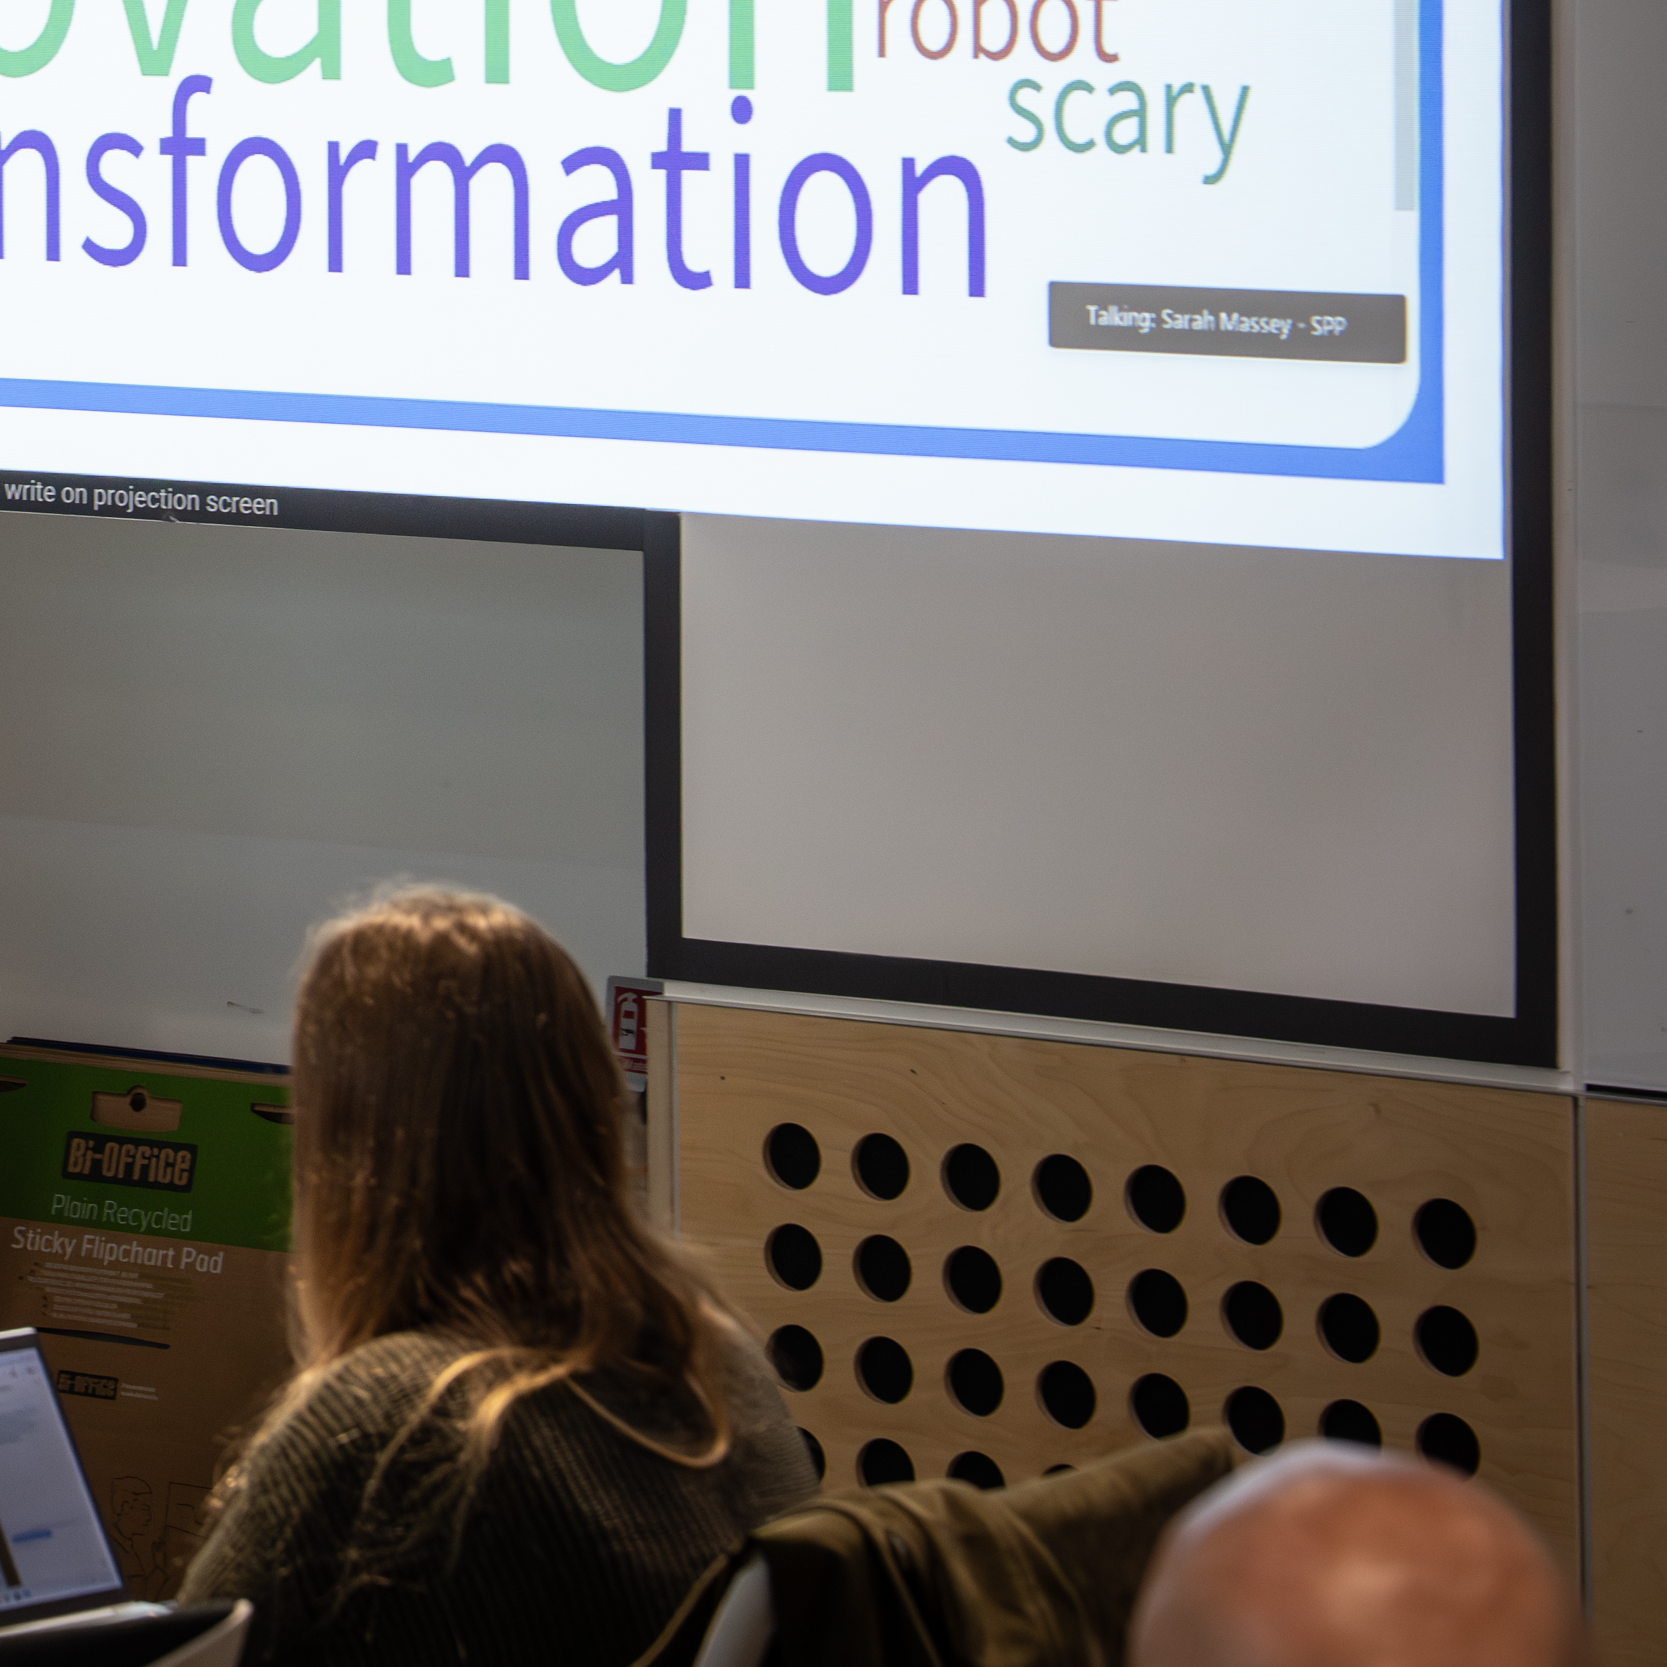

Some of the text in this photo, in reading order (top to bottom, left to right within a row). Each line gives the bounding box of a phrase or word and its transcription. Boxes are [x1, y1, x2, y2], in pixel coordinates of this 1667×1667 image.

[1005, 78, 1251, 185] scary
[1086, 304, 1157, 333] Talking:
[1161, 309, 1216, 332] Sarah
[1219, 312, 1293, 340] Massey
[1309, 315, 1348, 336] SPP
[4, 480, 56, 502] write
[61, 486, 88, 504] on
[94, 486, 200, 513] projection
[205, 493, 279, 516] screen
[51, 1194, 192, 1233] Plain Recycled
[11, 1226, 224, 1274] Sticky Flipchart Pad
